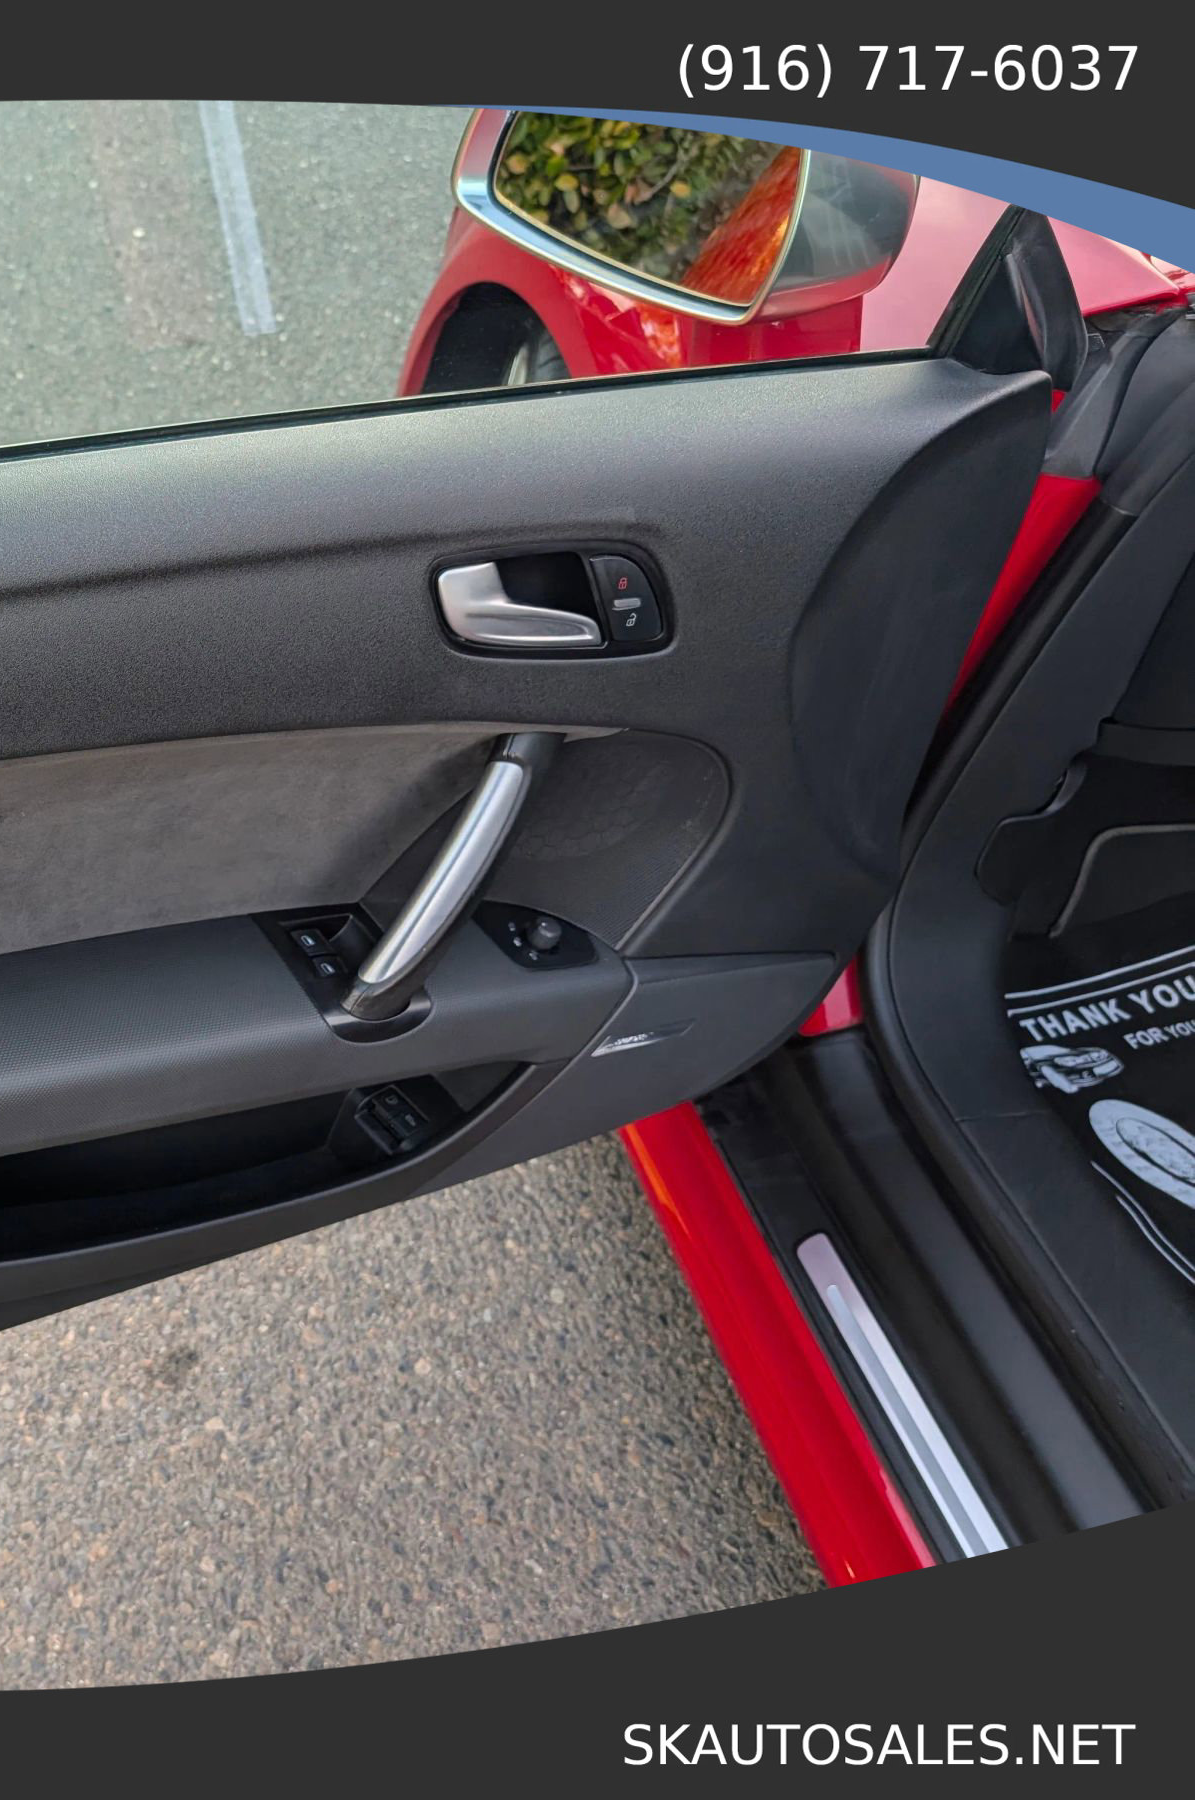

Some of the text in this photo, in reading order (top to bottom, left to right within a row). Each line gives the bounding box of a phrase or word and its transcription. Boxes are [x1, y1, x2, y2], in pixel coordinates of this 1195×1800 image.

[1019, 975, 1195, 1042] THANK YOU
[1123, 1027, 1169, 1050] FOR
